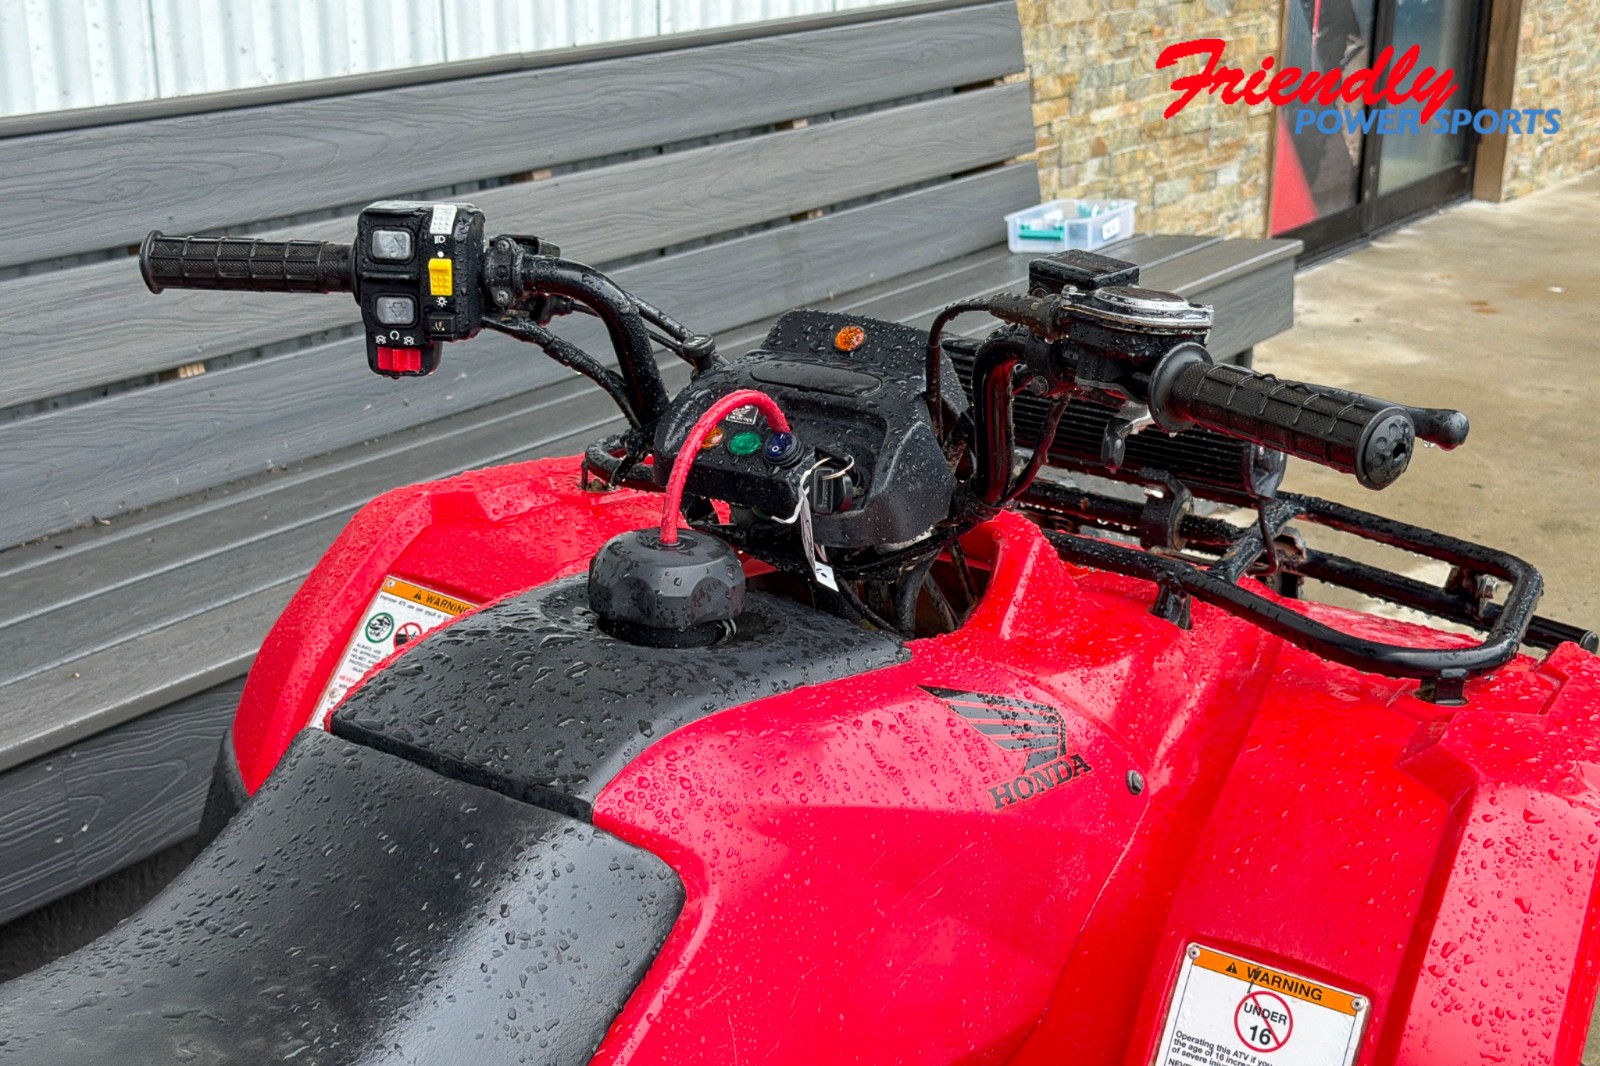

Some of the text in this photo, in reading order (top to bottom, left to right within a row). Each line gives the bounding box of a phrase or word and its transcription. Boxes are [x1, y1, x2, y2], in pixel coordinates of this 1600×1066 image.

[988, 753, 1092, 809] HONDA
[1247, 967, 1323, 1001] WARNING
[1243, 1002, 1287, 1025] UNDER
[1249, 1025, 1272, 1045] 16
[1171, 1046, 1180, 1054] of
[1181, 1050, 1207, 1064] severe
[1173, 1038, 1186, 1048] the
[1188, 1044, 1203, 1053] age
[1204, 1047, 1213, 1057] of
[1215, 1052, 1225, 1061] 16
[1175, 1030, 1214, 1050] Operating
[1216, 1044, 1231, 1055] this
[1233, 1050, 1250, 1060] ATV
[1250, 1055, 1257, 1064] if
